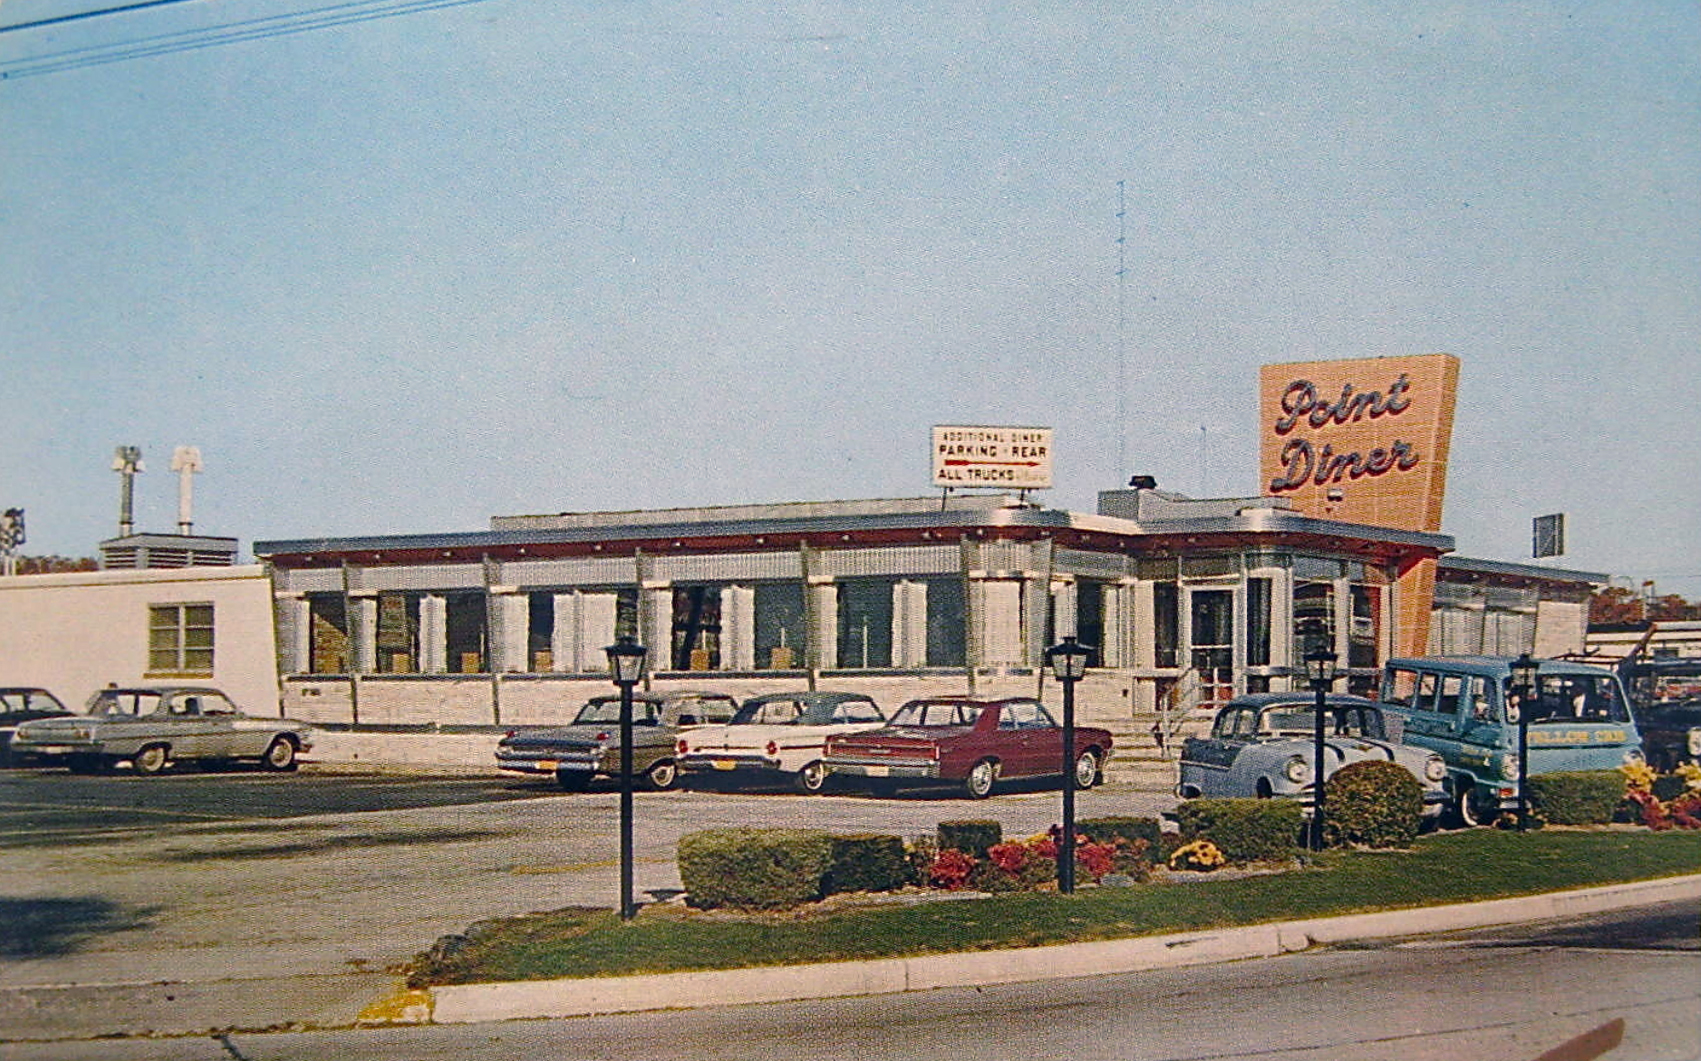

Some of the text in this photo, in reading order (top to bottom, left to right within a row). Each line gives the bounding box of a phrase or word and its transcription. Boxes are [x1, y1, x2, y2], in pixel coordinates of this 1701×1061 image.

[1275, 373, 1412, 436] Point
[943, 432, 1042, 443] ADDITIONAL DINER
[939, 445, 1047, 458] PARKING REAR
[1270, 439, 1419, 493] Diner
[938, 469, 962, 480] ALL
[967, 469, 1014, 481] TRUCKS
